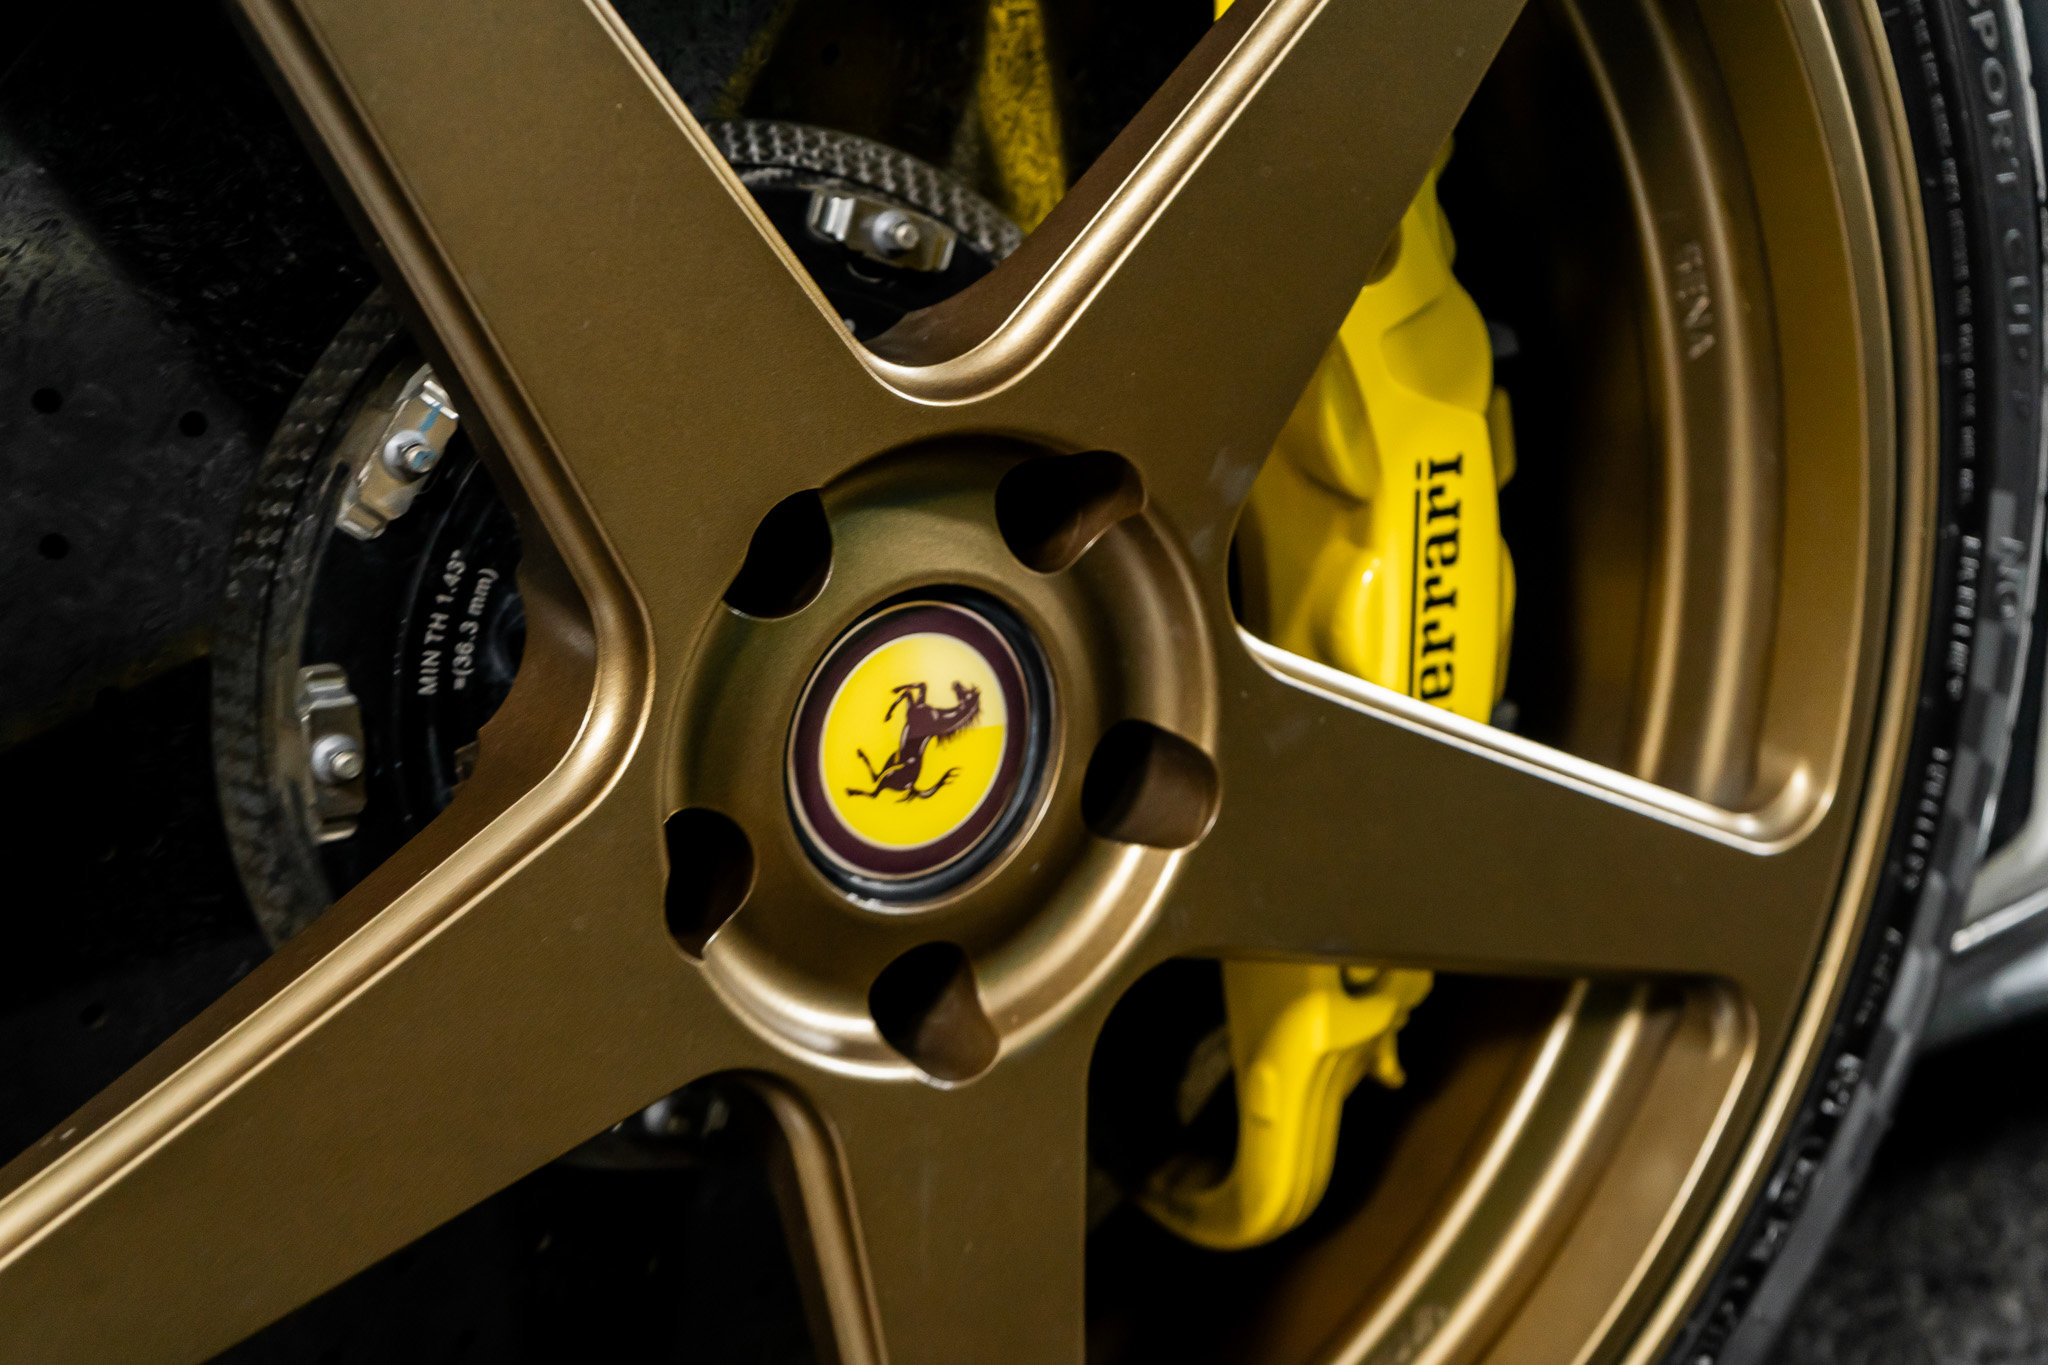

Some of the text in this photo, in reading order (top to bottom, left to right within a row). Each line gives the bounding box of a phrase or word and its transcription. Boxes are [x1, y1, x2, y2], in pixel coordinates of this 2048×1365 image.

[467, 567, 499, 616] mm)
[1408, 453, 1463, 706] errari
[424, 612, 449, 645] TH
[417, 650, 442, 695] MIN
